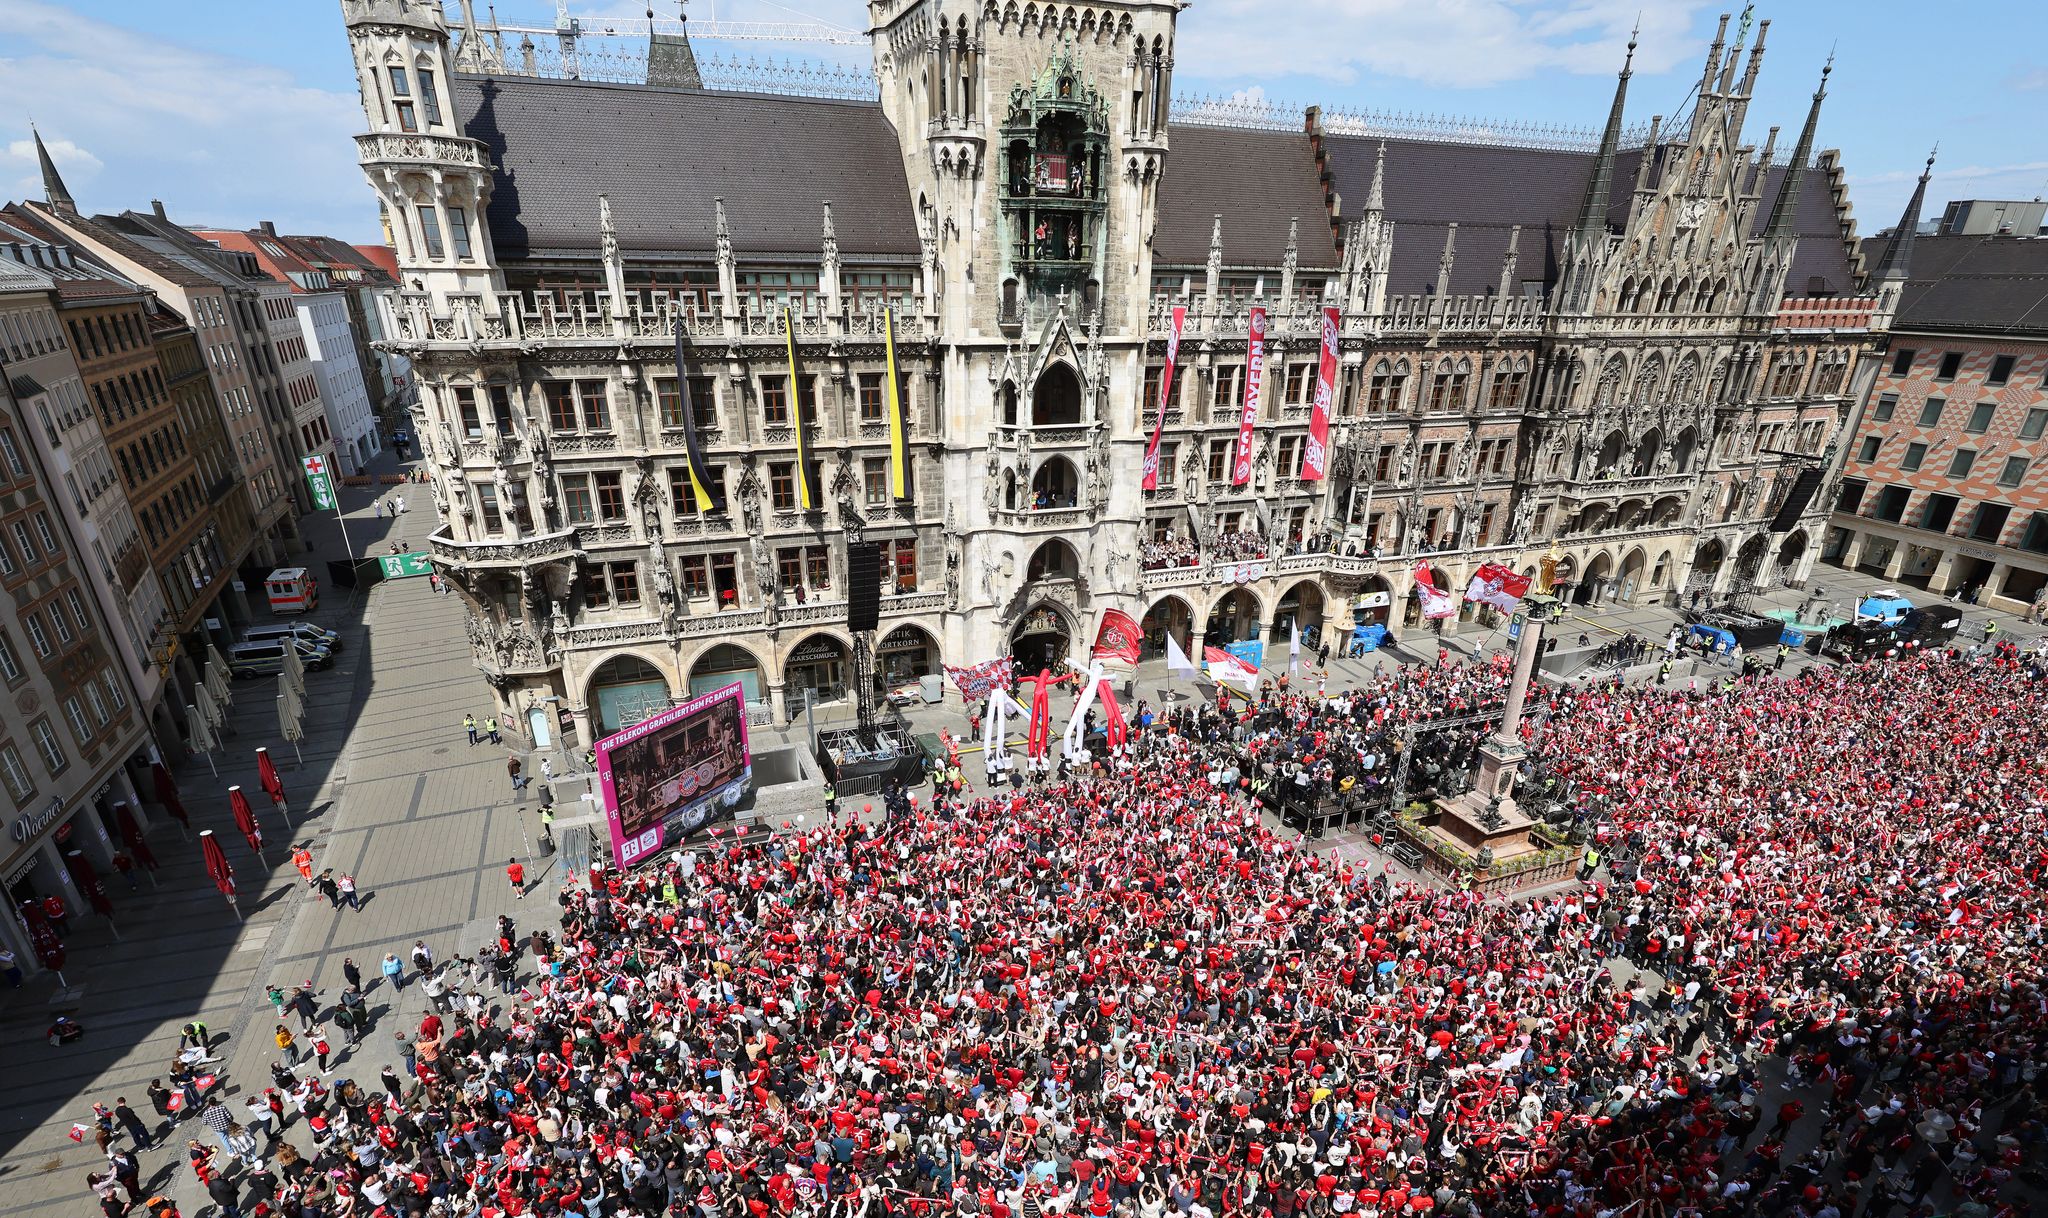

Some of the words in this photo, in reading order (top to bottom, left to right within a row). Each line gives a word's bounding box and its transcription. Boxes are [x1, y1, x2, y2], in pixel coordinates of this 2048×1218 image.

[1244, 340, 1264, 424] BAYERN
[1513, 614, 1521, 623] S
[1511, 625, 1519, 634] U
[796, 642, 829, 655] Linda
[878, 639, 919, 649] ORTKORN
[601, 739, 614, 751] DIE
[615, 725, 648, 744] TELEKOM
[648, 705, 690, 730] GRATULIERT
[690, 700, 705, 712] DEM
[705, 696, 713, 705] FC
[714, 684, 740, 702] BAYERN!
[4, 856, 38, 891] ONDITOREI
